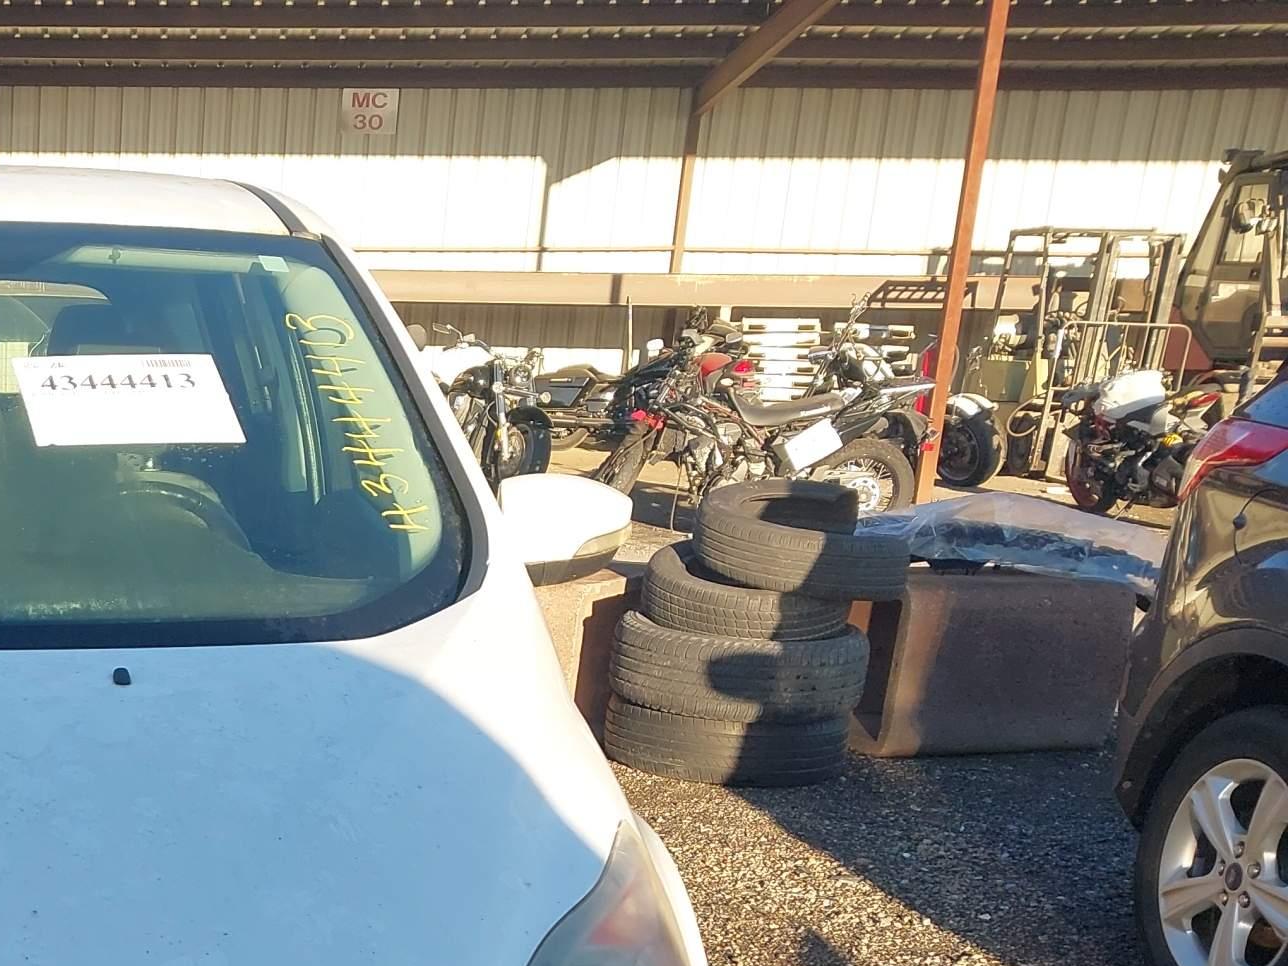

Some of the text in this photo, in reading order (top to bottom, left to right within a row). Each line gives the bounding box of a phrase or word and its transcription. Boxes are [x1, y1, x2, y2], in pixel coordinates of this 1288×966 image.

[352, 92, 388, 109] MC
[353, 113, 384, 130] 30
[40, 373, 197, 391] 43444413
[284, 312, 431, 531] 43444413
